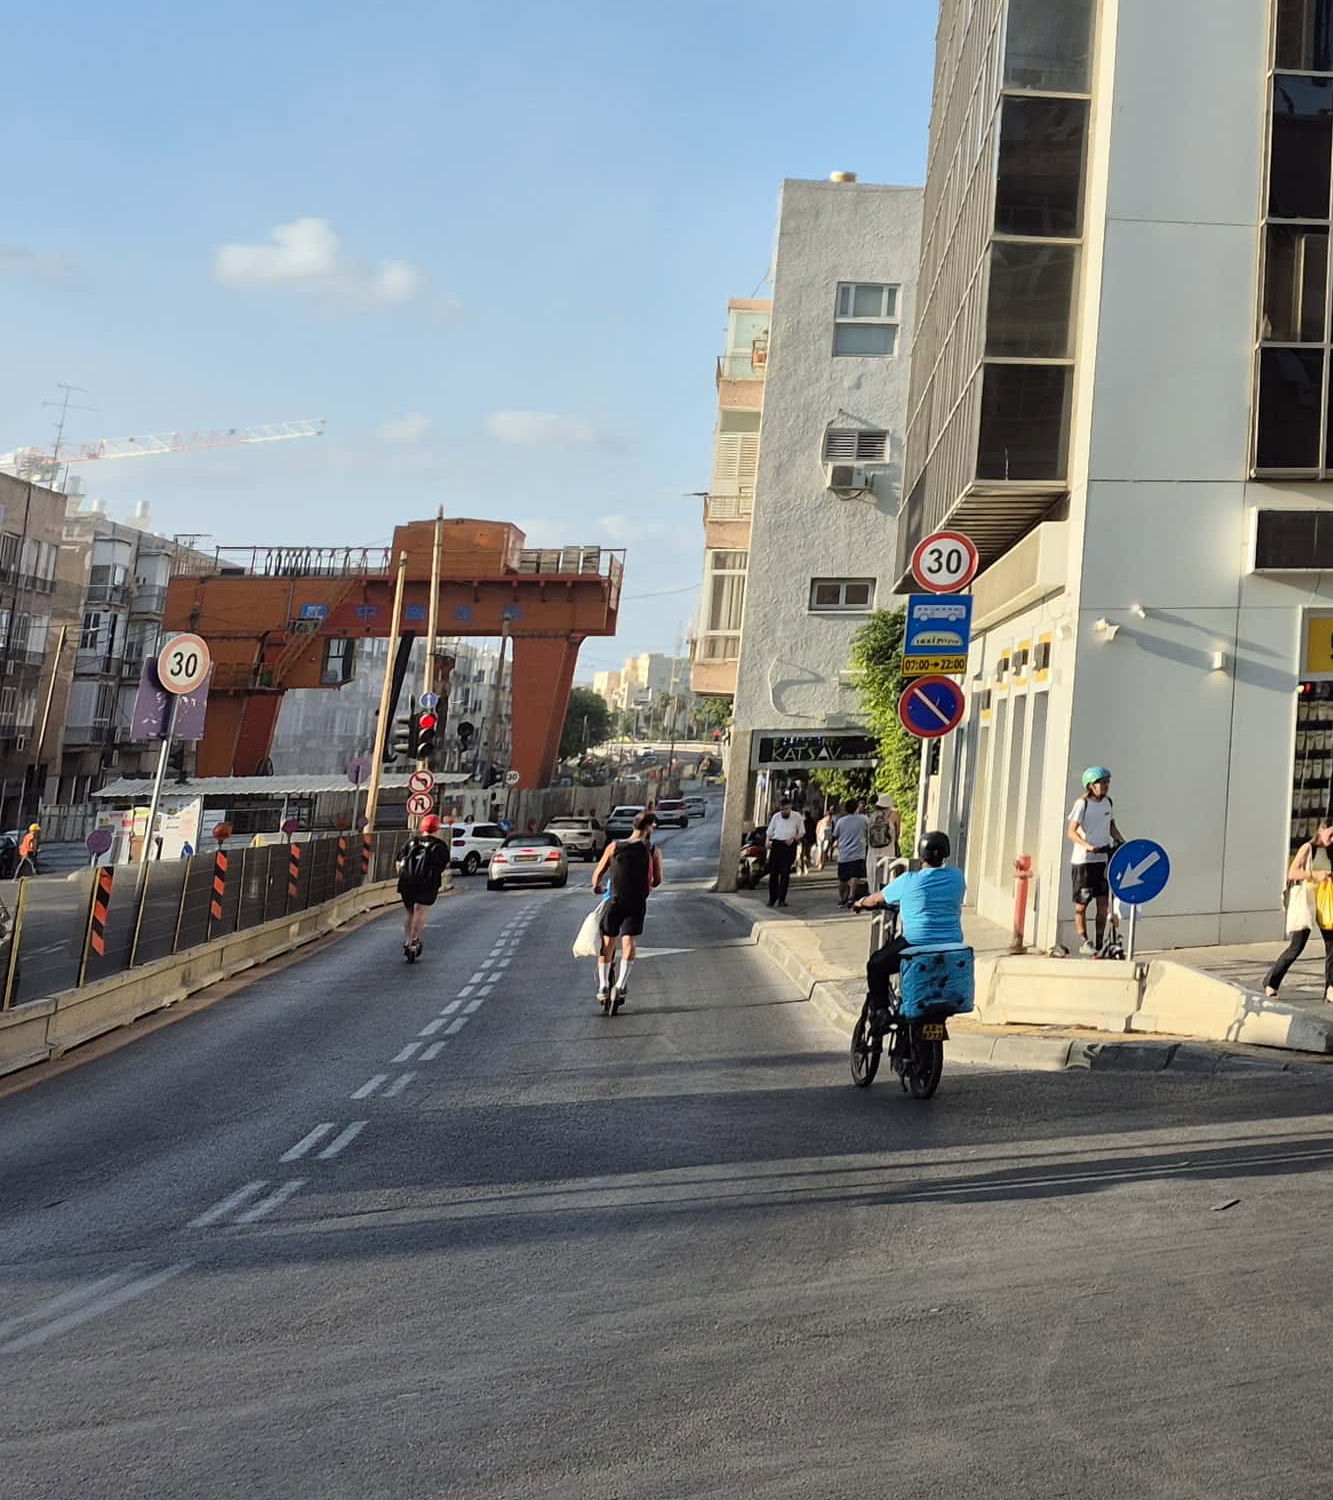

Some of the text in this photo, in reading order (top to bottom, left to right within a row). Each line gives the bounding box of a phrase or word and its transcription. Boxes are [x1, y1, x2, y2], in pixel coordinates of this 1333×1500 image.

[927, 548, 962, 574] 30
[170, 651, 198, 678] 30
[904, 658, 965, 671] 07:00 22:00
